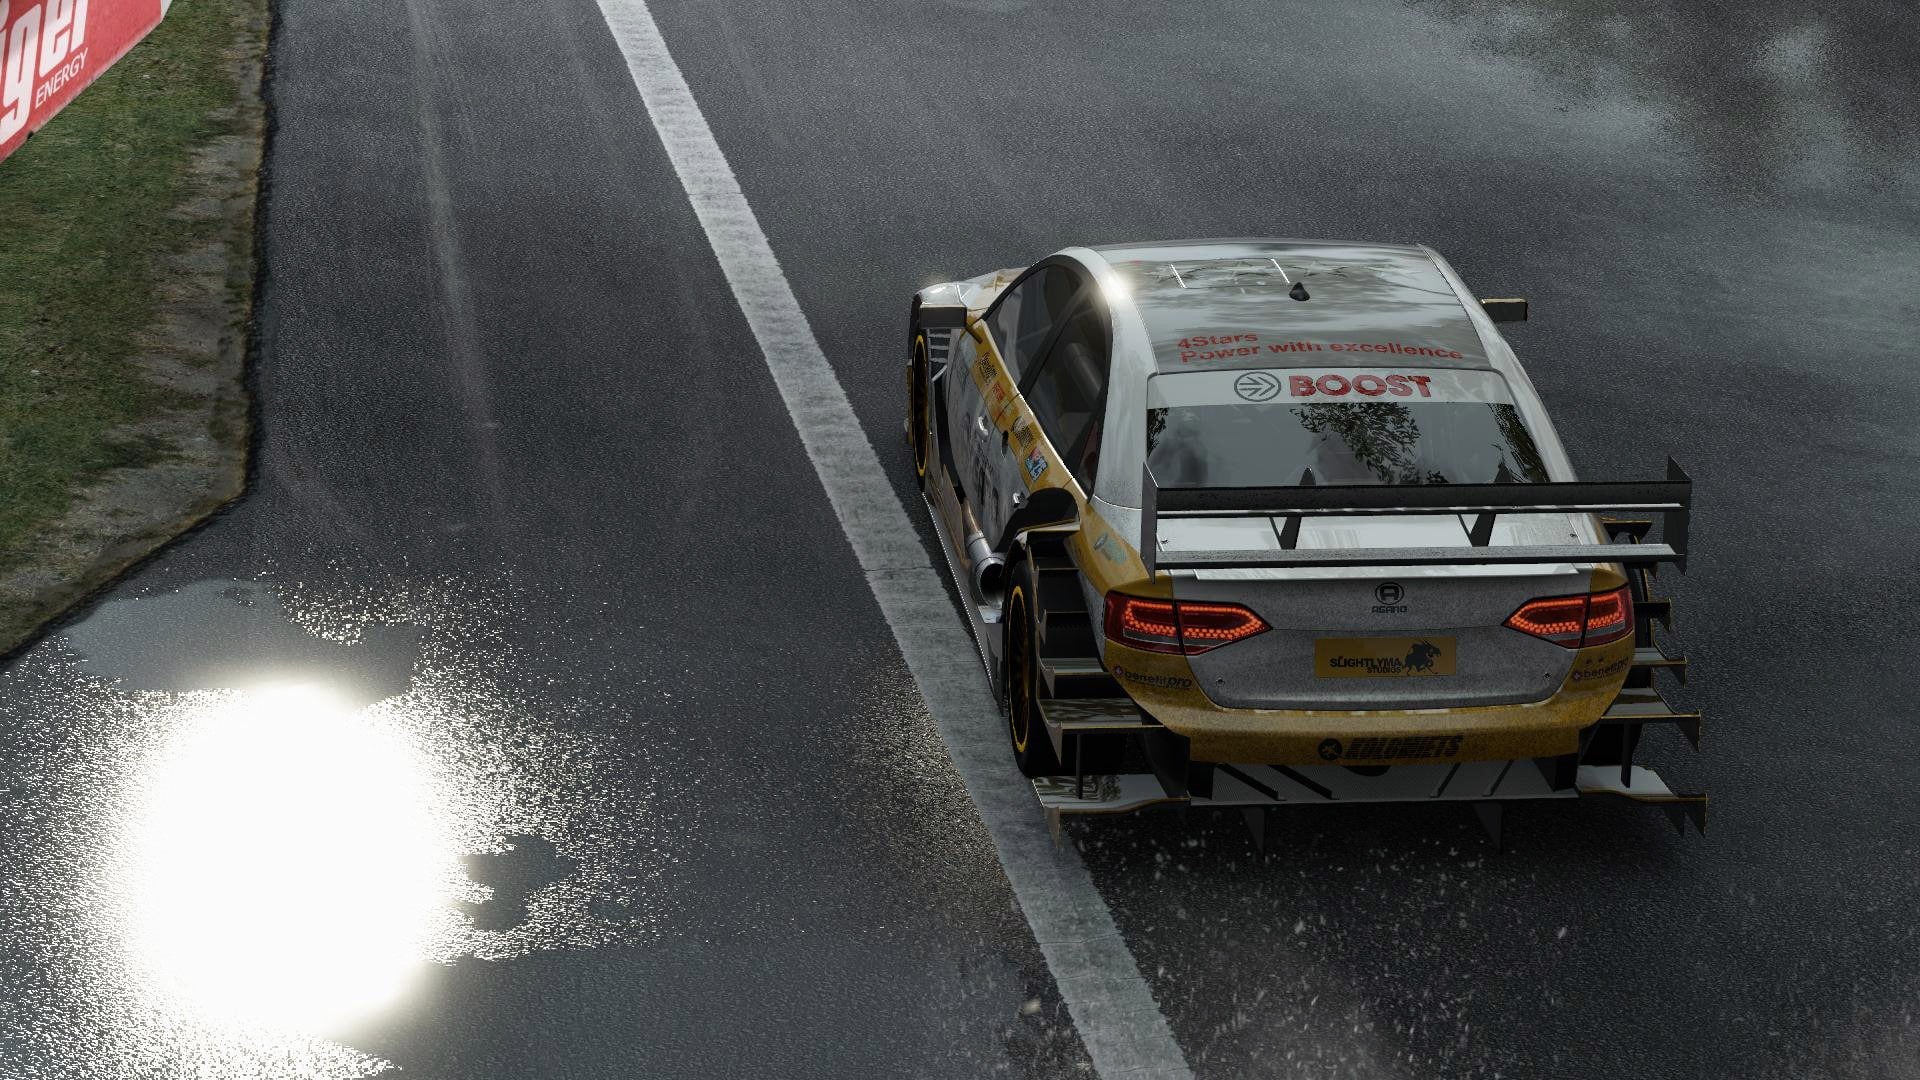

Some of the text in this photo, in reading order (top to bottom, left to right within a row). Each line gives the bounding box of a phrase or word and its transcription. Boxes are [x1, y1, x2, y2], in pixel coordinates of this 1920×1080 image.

[35, 47, 88, 109] ENERGY
[1176, 332, 1259, 349] 4Stars
[1180, 342, 1464, 363] Power with excellence
[1288, 374, 1433, 398] BOOST
[1366, 666, 1402, 674] STUDIOS
